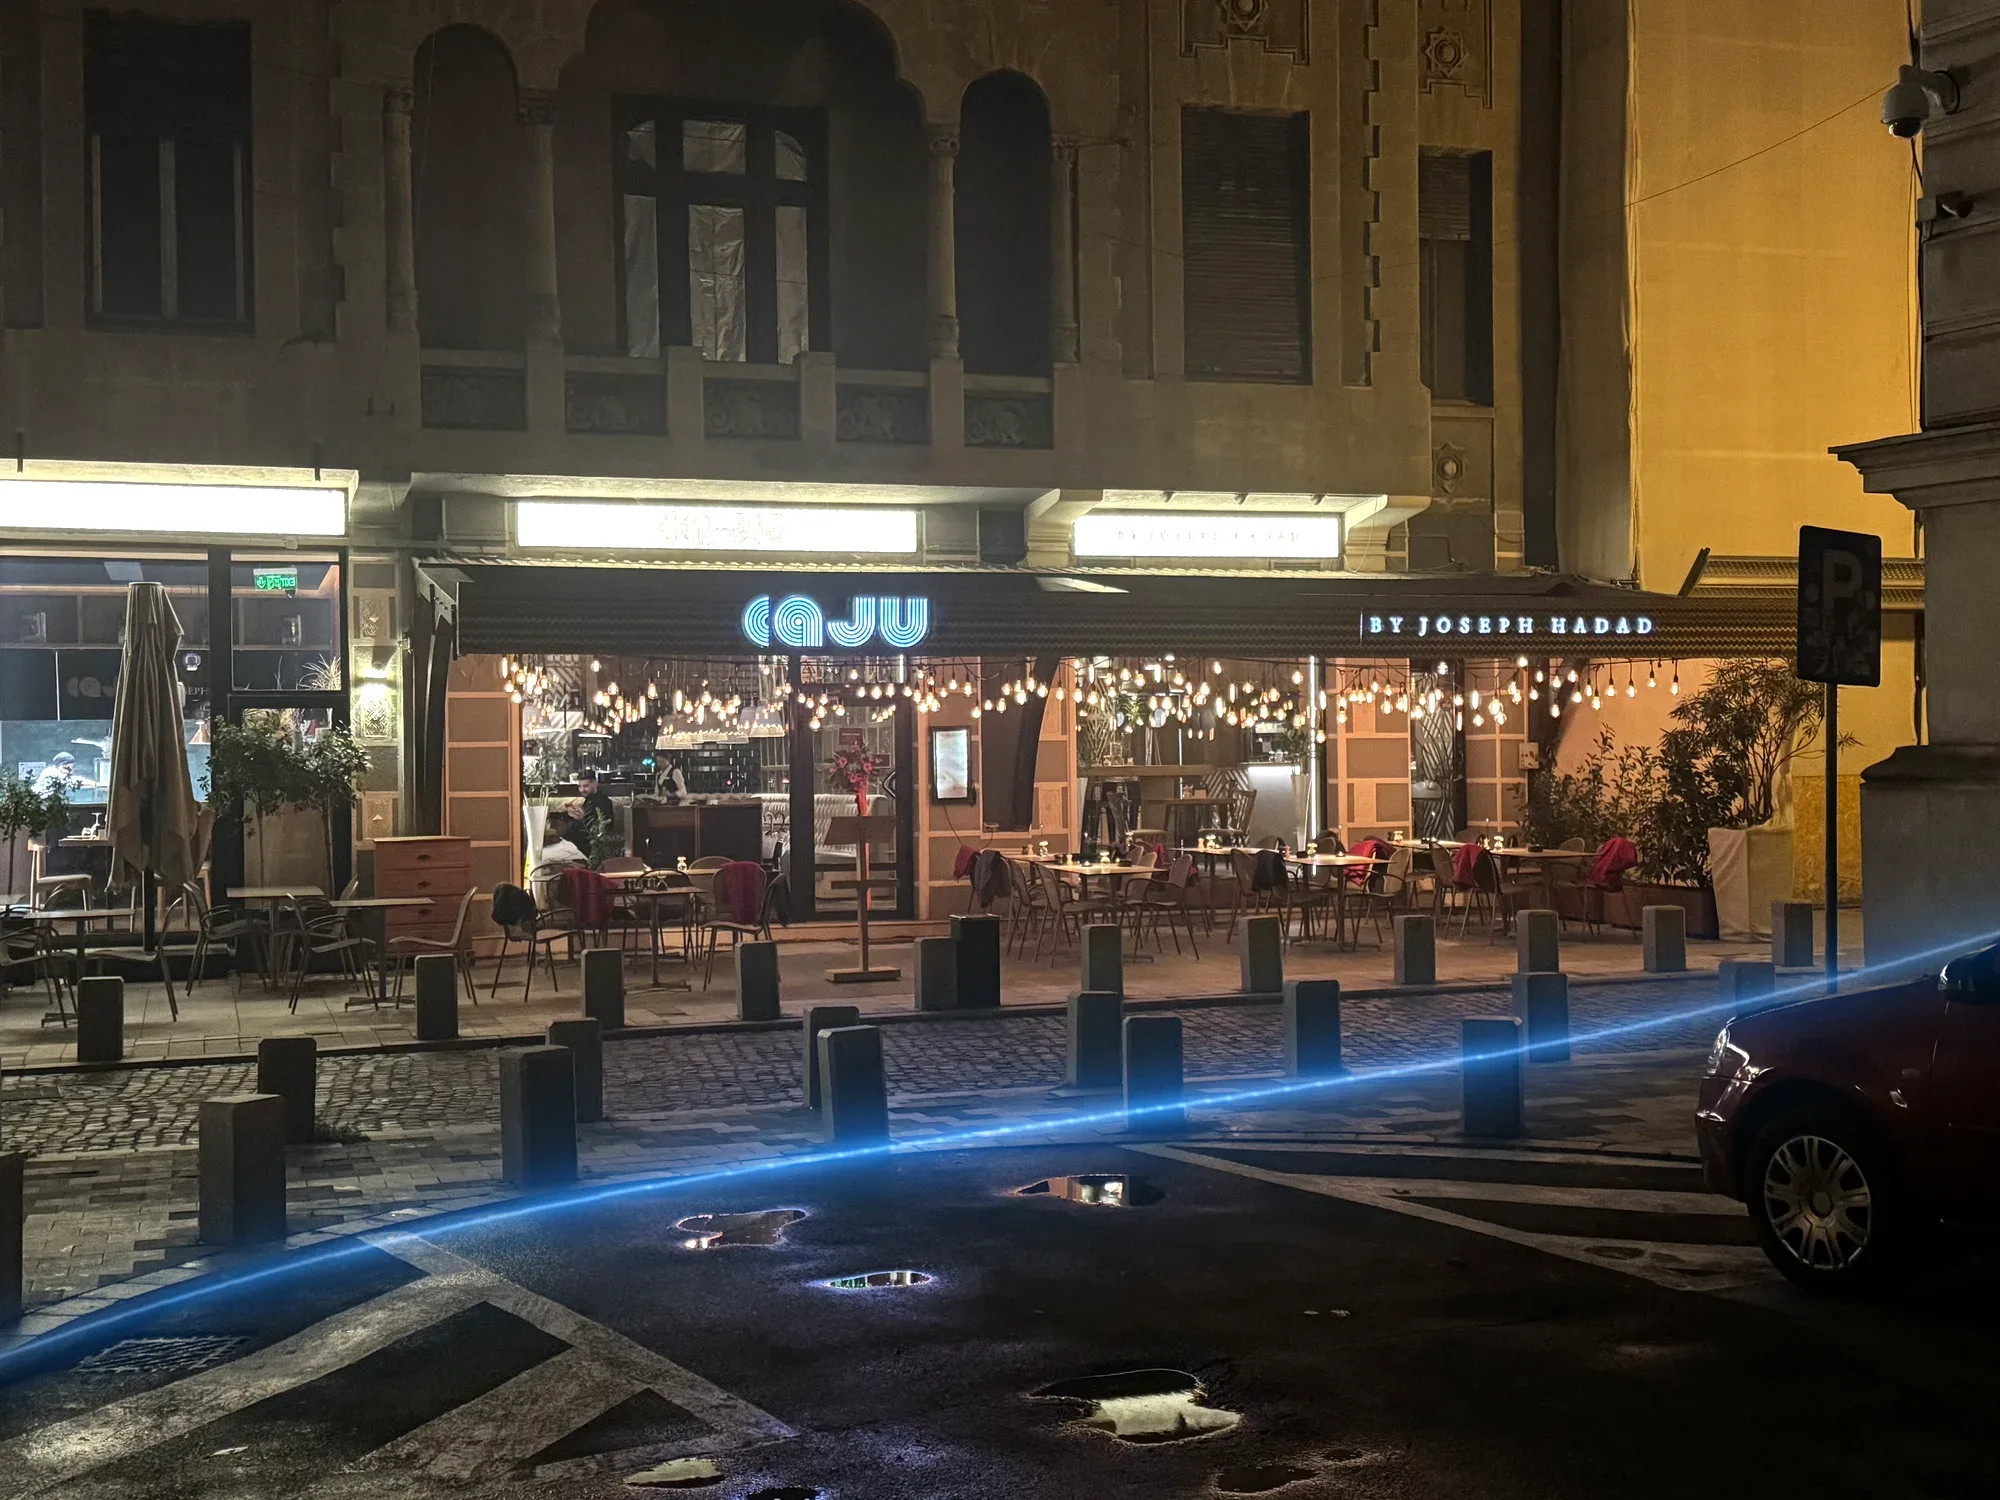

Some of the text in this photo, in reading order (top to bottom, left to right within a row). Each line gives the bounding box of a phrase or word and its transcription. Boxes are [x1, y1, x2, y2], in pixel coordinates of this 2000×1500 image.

[1823, 548, 1864, 610] P
[1369, 616, 1652, 637] BY JOSEPH HADAD
